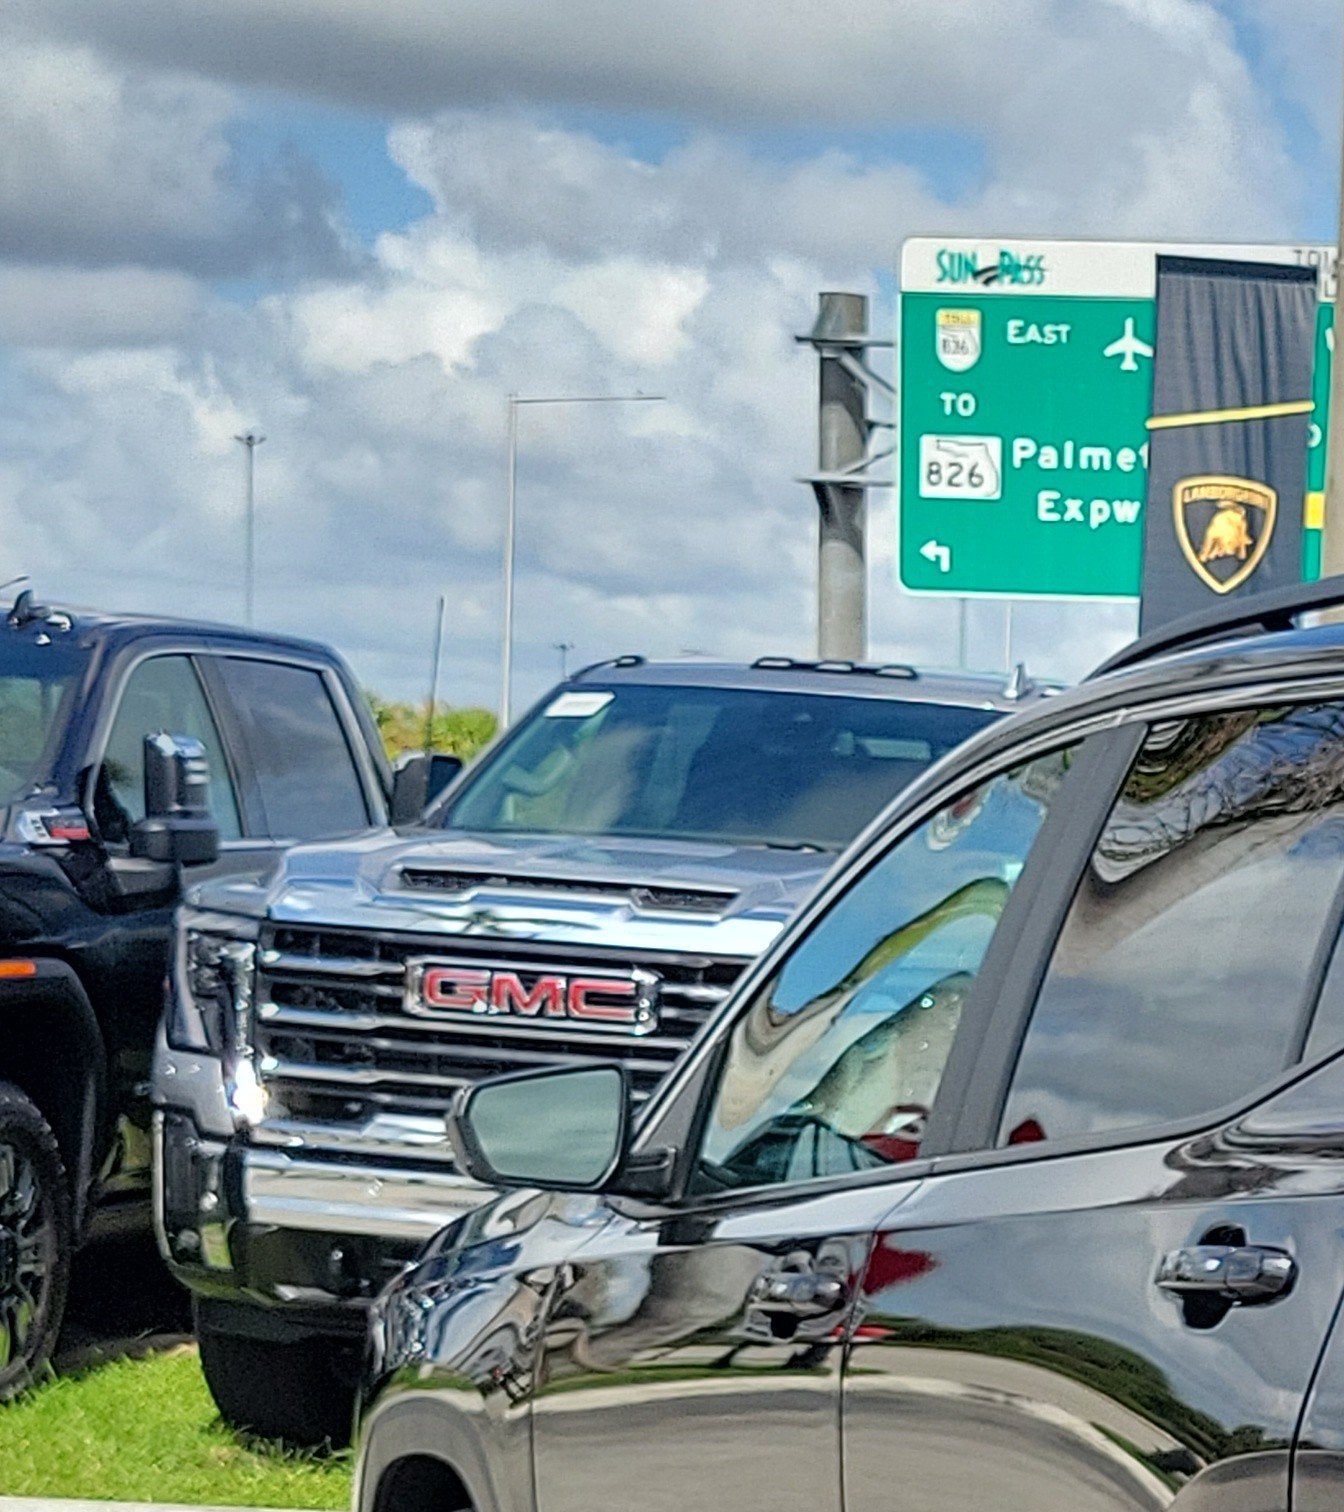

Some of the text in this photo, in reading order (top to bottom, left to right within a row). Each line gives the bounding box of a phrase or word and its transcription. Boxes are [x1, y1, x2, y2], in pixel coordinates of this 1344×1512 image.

[940, 392, 976, 417] TO
[926, 461, 984, 488] 826
[423, 966, 637, 1021] GMC
